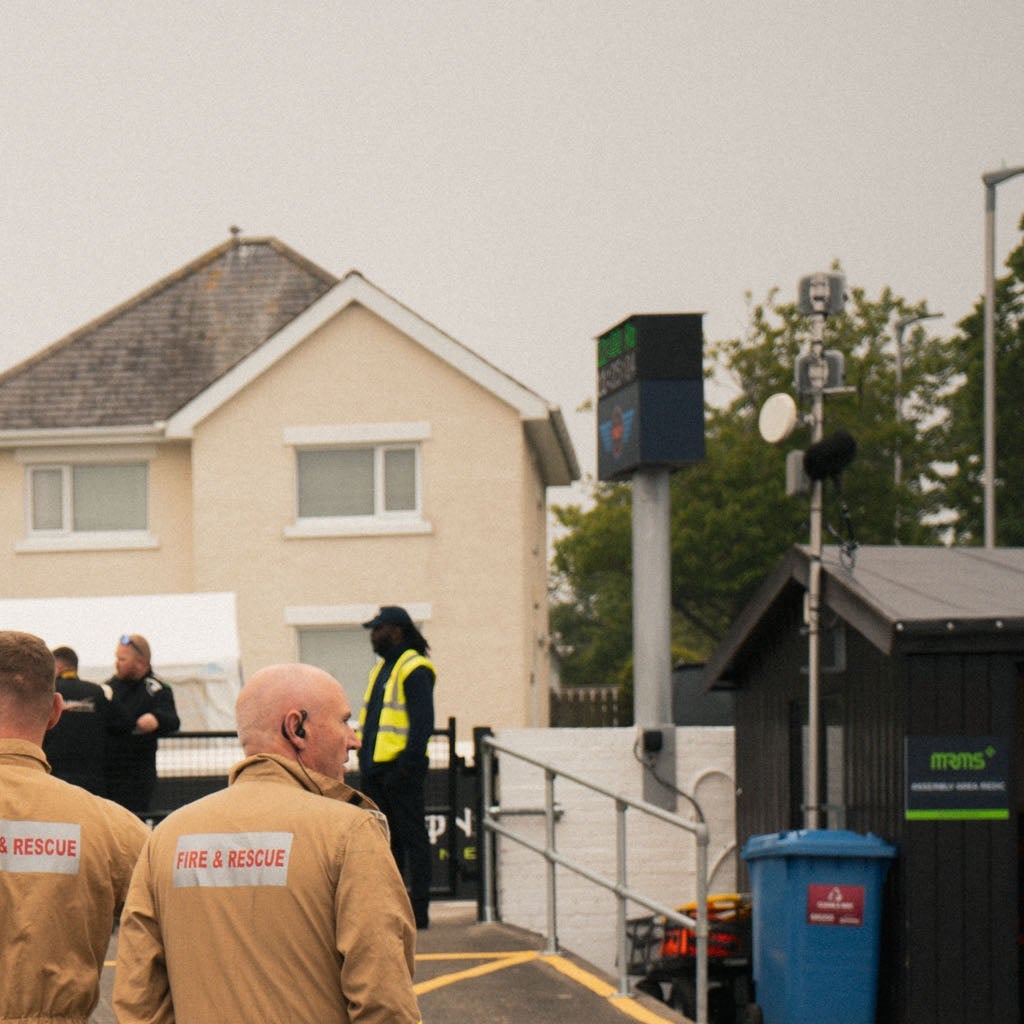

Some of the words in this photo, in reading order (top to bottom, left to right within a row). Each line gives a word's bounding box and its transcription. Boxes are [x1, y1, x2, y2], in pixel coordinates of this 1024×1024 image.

[13, 838, 77, 857] RESCUE
[176, 850, 208, 870] FIRE
[212, 850, 223, 868] &
[228, 849, 286, 868] RESCUE
